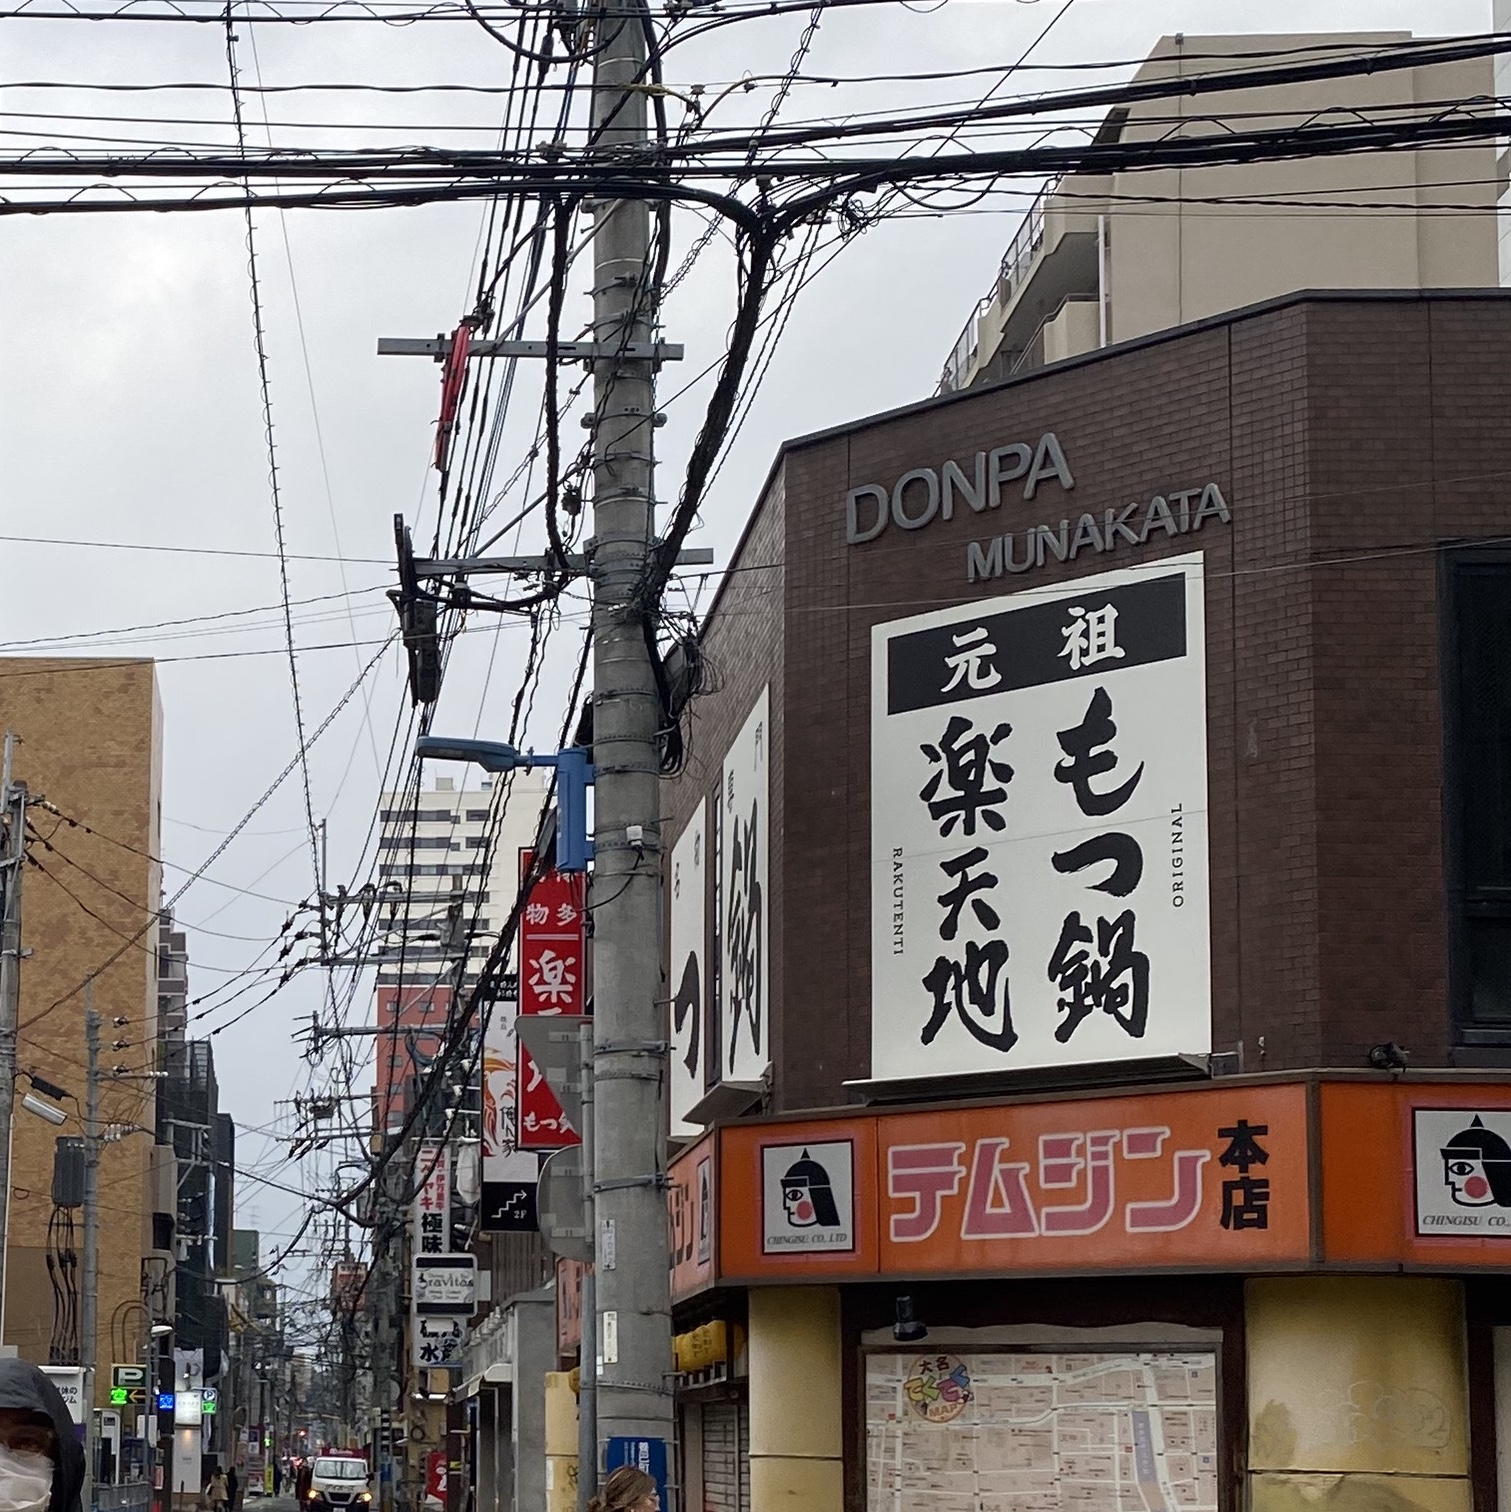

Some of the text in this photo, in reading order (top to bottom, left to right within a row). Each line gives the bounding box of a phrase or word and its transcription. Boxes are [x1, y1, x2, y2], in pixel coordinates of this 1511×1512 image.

[845, 431, 1075, 546] DONPA
[967, 482, 1232, 584] MUNAKATA
[940, 603, 1126, 693] 元祖
[892, 846, 904, 956] RAKUTENTI
[918, 715, 1019, 1053] 楽天地
[1047, 686, 1151, 1044] もつ鍋
[1171, 803, 1184, 908] ORIGINAL
[888, 1125, 1212, 1244] テムジン
[1216, 1118, 1270, 1231] 本店
[1423, 1214, 1483, 1227] CHINGISU
[118, 1367, 144, 1386] P
[918, 1355, 950, 1376] 大名
[928, 1402, 958, 1418] MAP
